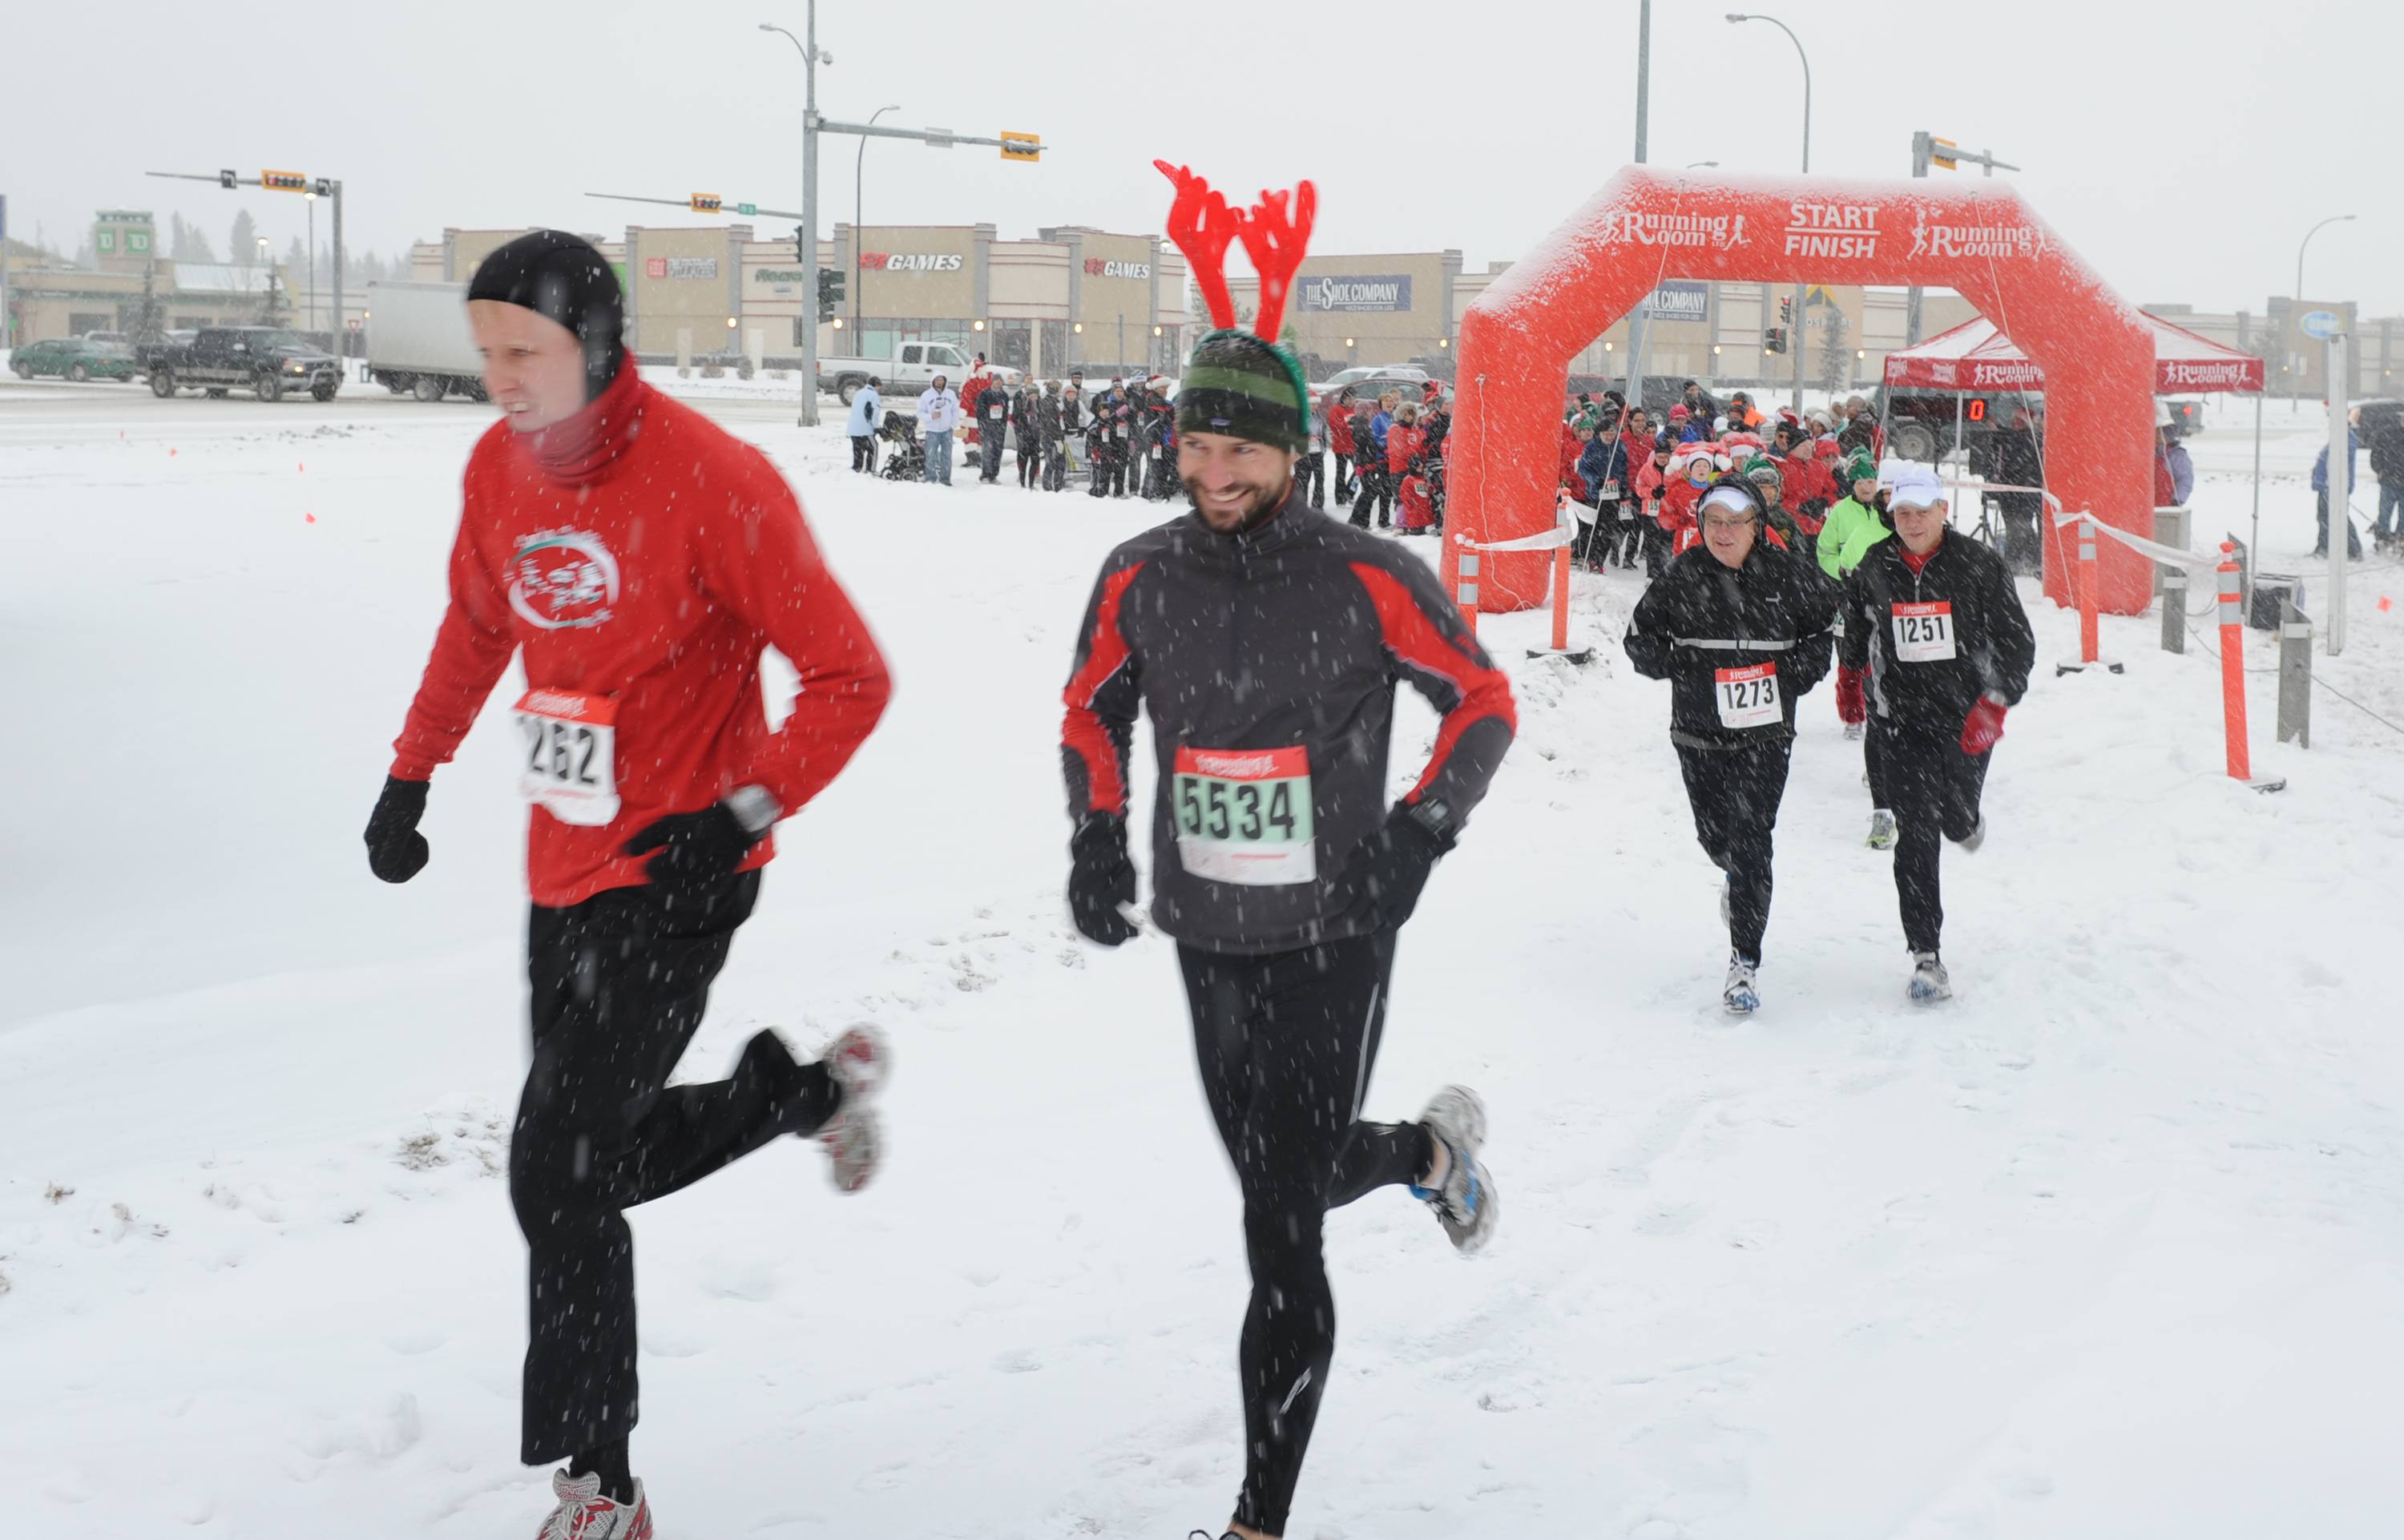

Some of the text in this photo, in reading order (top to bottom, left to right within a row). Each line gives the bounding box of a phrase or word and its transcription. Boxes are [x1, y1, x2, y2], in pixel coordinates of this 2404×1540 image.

[1622, 211, 1728, 244] Running
[1790, 204, 1879, 229] START
[1784, 235, 1875, 259] FINISH
[1928, 222, 2032, 256] Running
[886, 254, 962, 270] GAMES
[1103, 261, 1151, 279] GAMES
[1306, 277, 1399, 309] THE SHOE COMPANY
[1660, 290, 1706, 311] COMPANY
[2177, 362, 2238, 384] Running
[1970, 400, 1984, 421] 0
[1898, 615, 1945, 643] 1251
[1724, 678, 1774, 710] 1273
[1183, 776, 1295, 840] 5534
